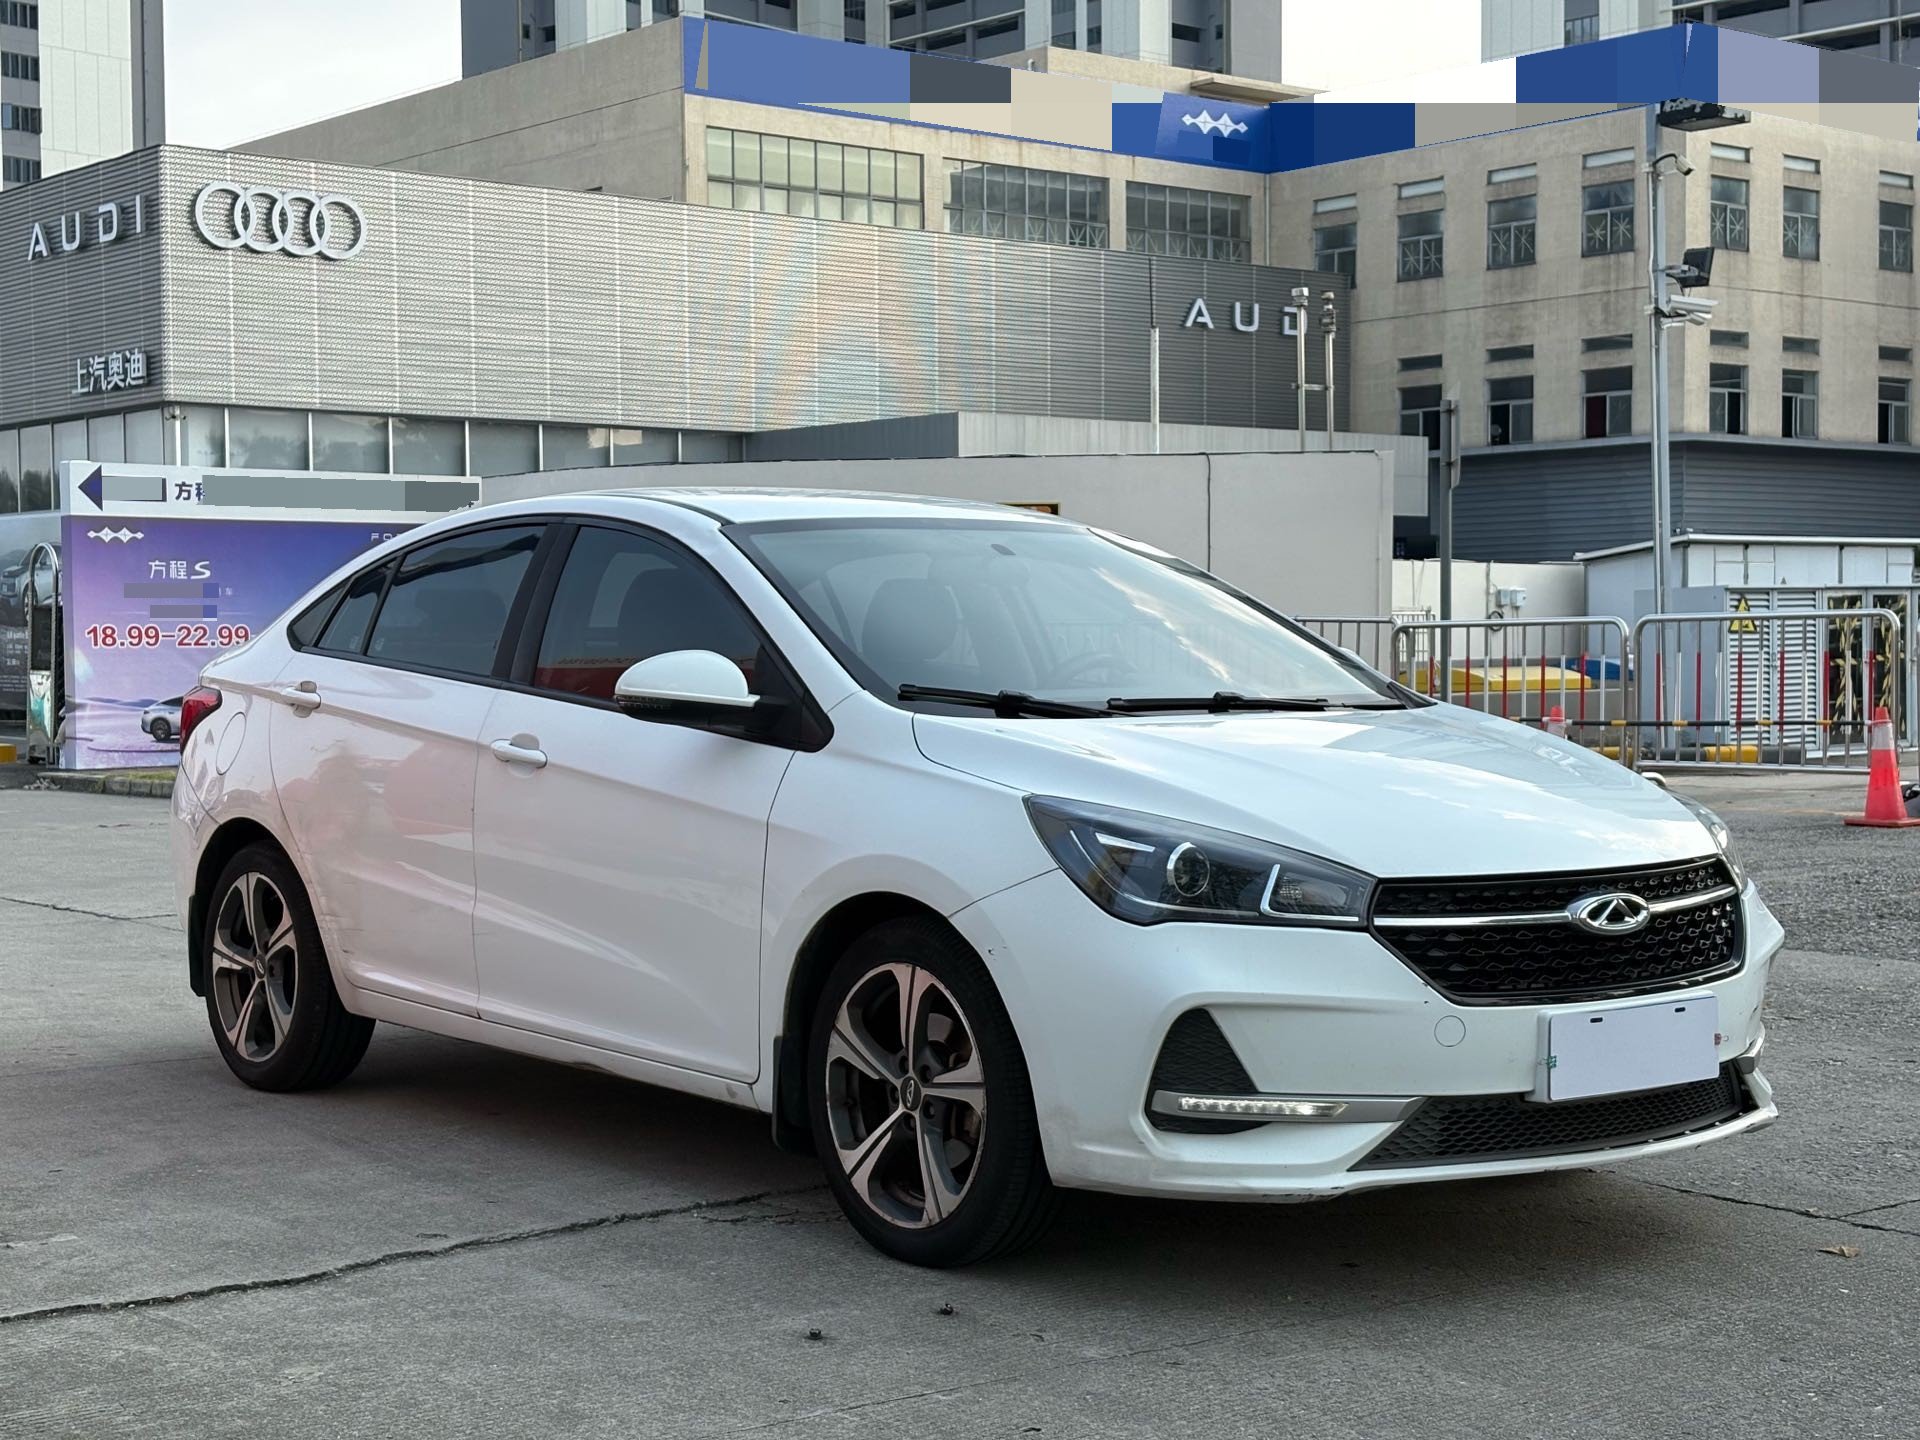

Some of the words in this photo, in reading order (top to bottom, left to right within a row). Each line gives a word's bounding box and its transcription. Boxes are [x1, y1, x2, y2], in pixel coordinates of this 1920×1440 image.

[28, 194, 144, 260] AUDI
[1184, 298, 1309, 336] AUD
[72, 348, 146, 394] 上汽奥迪
[371, 532, 402, 542] FO
